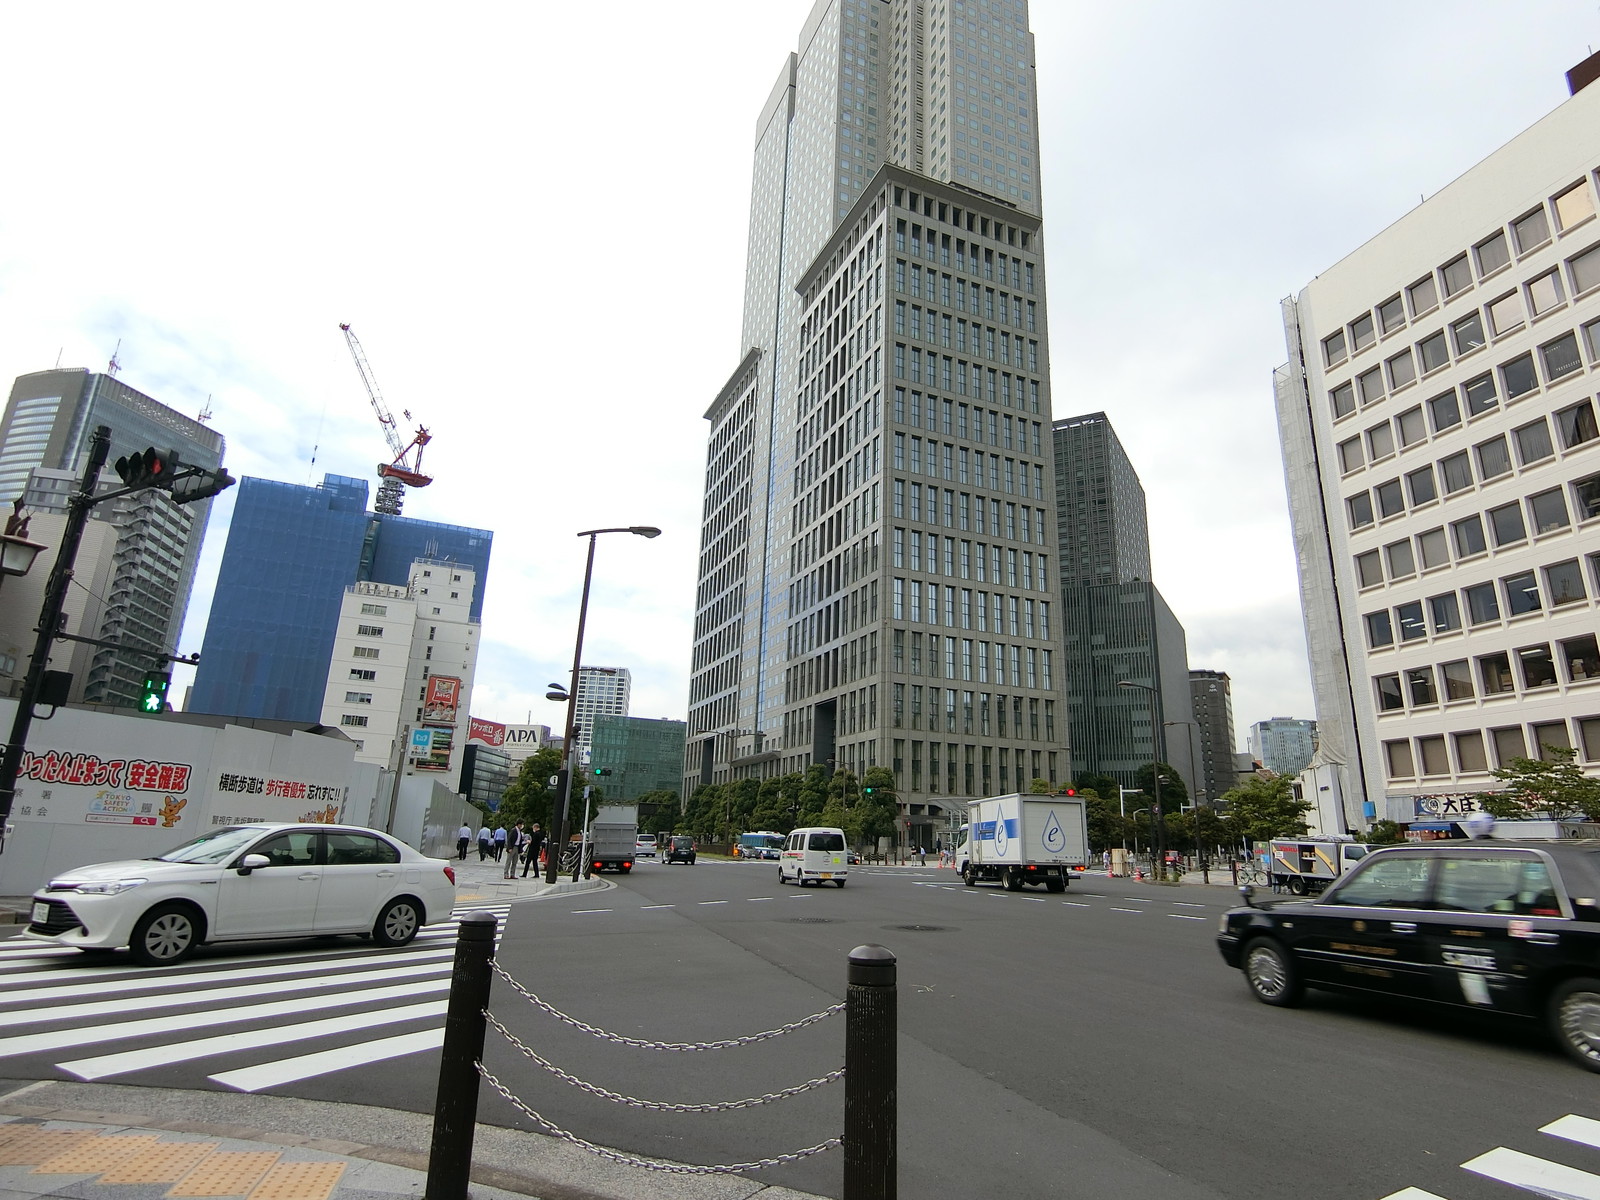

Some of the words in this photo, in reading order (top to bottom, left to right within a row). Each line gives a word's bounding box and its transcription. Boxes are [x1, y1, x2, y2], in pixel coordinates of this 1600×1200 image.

[472, 721, 493, 734] サッポロ
[505, 729, 537, 743] APA
[16, 751, 125, 788] いったん止まって
[126, 760, 191, 793] 安全確認
[218, 773, 264, 795] 横断歩道は
[265, 779, 307, 799] 歩行者優先
[105, 793, 131, 802] TOKYO
